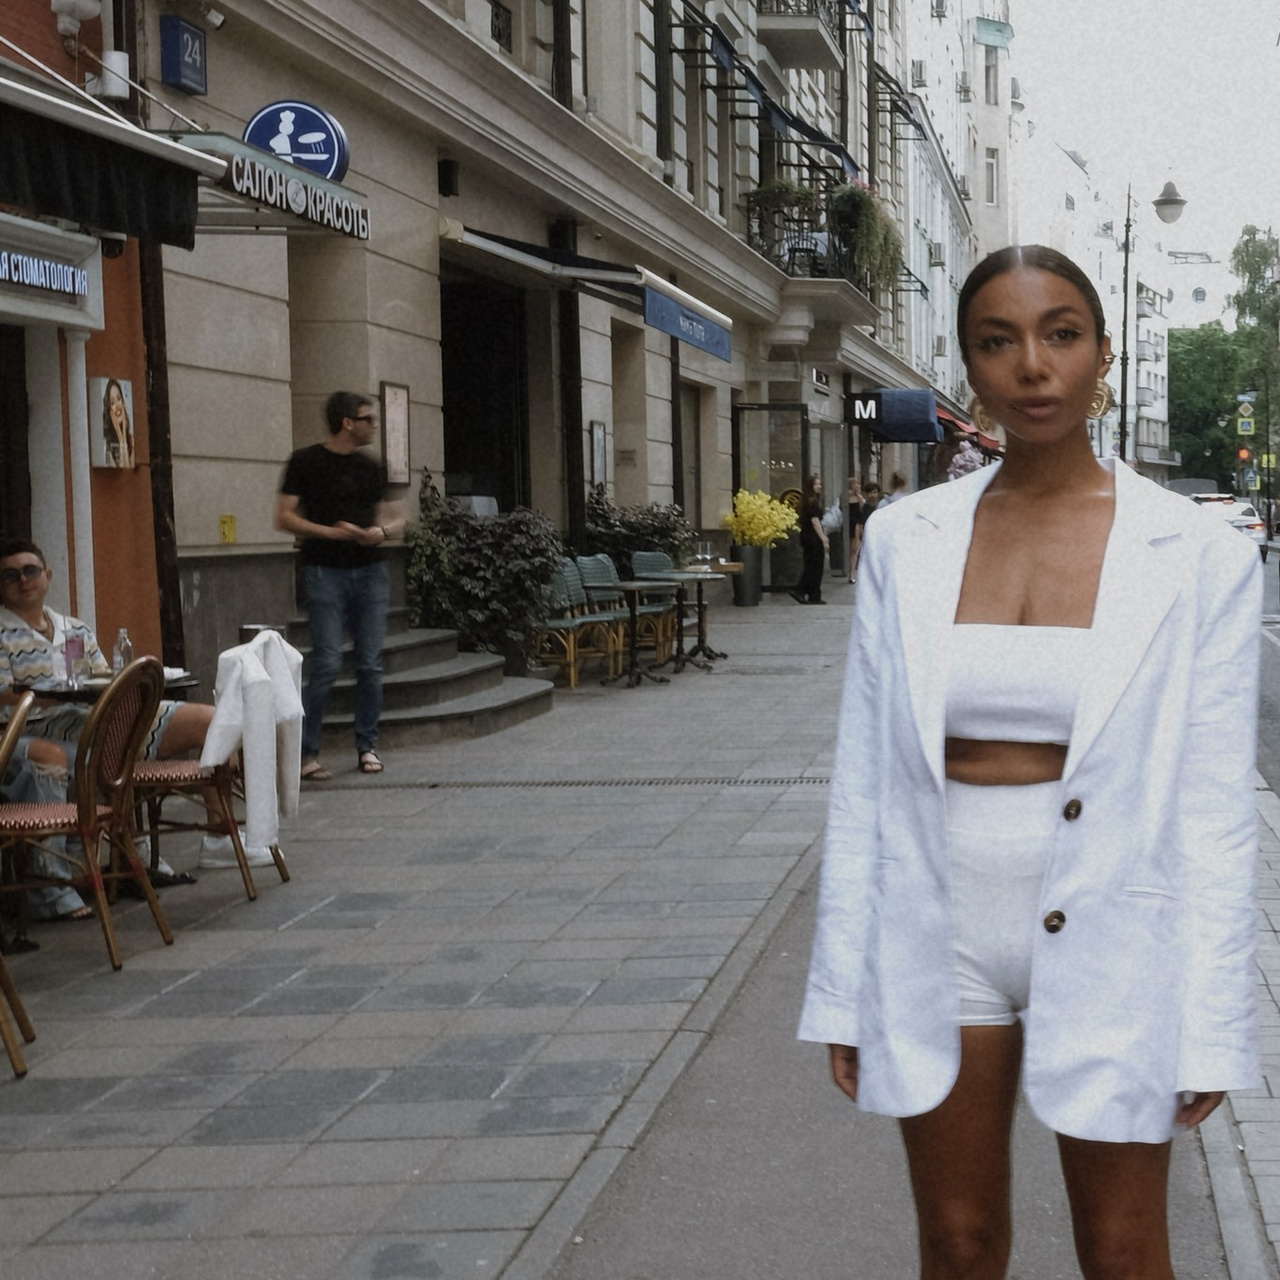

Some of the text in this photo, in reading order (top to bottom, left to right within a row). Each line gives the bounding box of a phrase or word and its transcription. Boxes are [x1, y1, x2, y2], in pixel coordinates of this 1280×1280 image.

[183, 32, 201, 68] 24
[231, 153, 372, 241] САЛОН КРАСОТЫ
[10, 253, 88, 296] СТОМАТОЛОГИЯ
[855, 399, 877, 420] M
